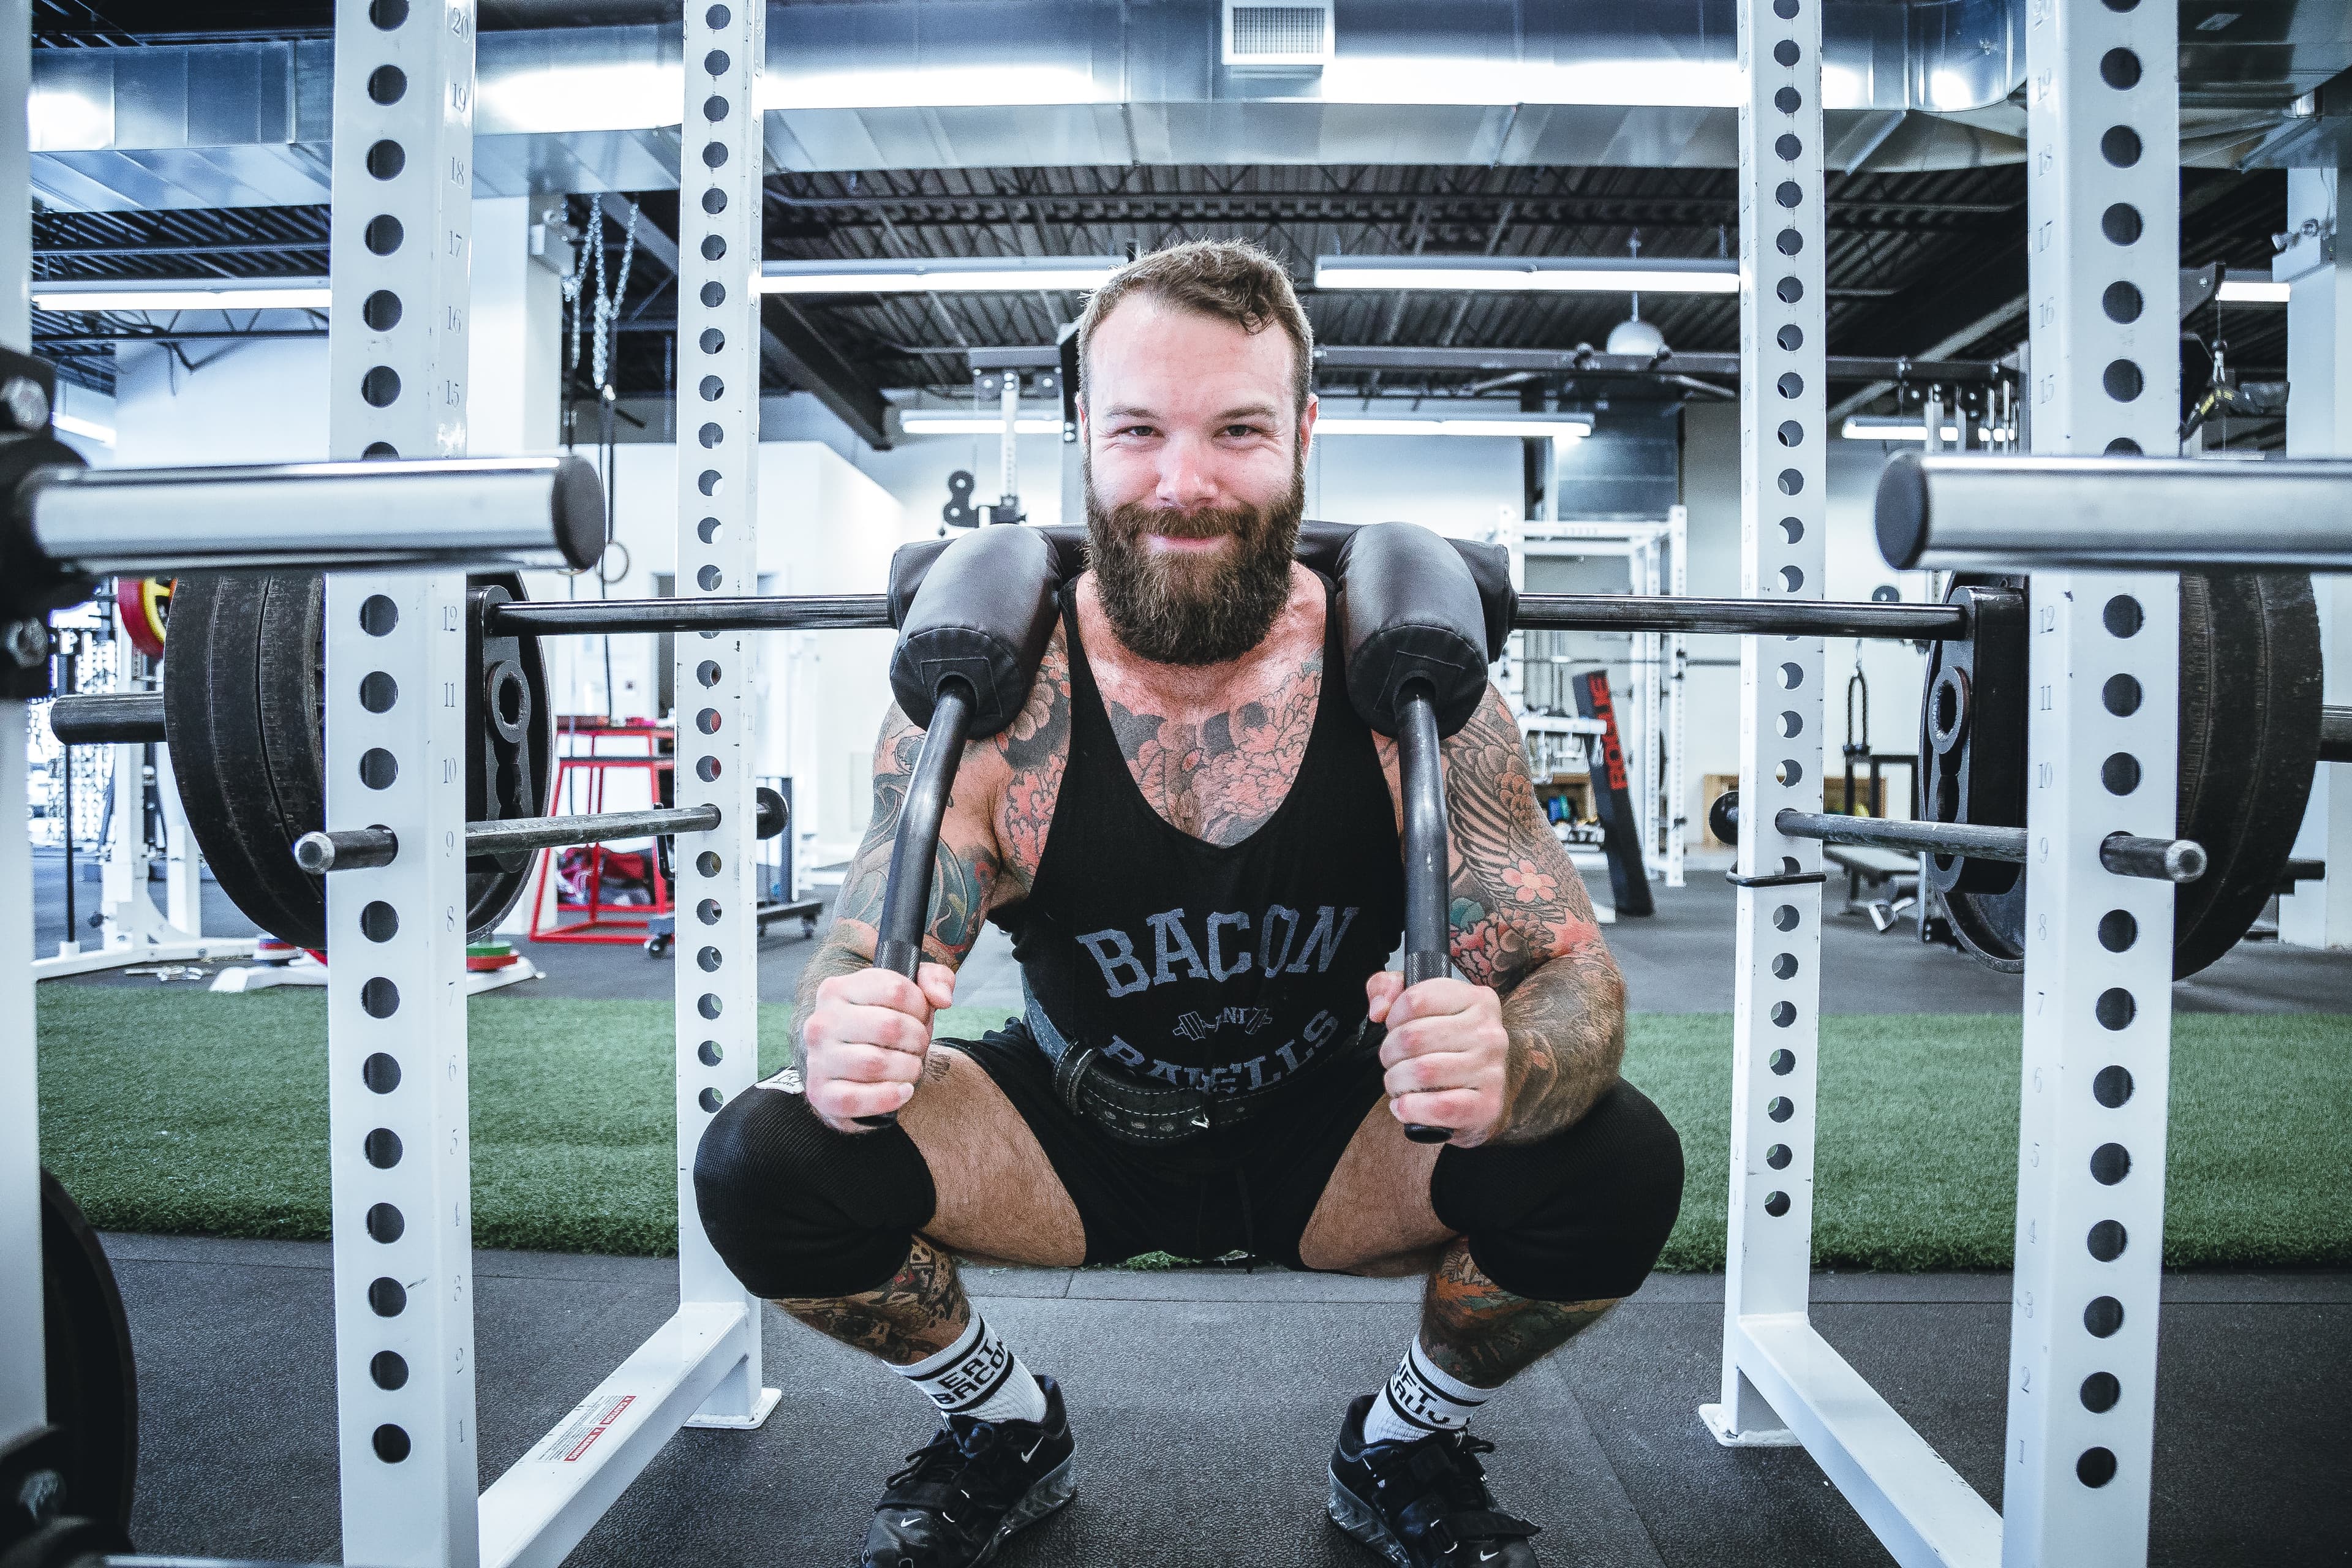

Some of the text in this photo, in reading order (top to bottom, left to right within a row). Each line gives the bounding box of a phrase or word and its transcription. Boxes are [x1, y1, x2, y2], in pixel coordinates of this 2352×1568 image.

[451, 7, 470, 42] 20
[452, 83, 466, 113] 19
[2037, 67, 2052, 102] 19
[450, 156, 464, 188] 18
[2037, 144, 2052, 178] 18
[448, 230, 463, 258] 17
[2037, 220, 2053, 253] 17
[447, 305, 461, 335] 16
[2038, 296, 2055, 330] 16
[445, 379, 460, 409] 15
[2039, 374, 2055, 405] 15
[443, 605, 458, 632] 12
[2039, 605, 2056, 634] 12
[443, 681, 456, 708] 11
[2039, 684, 2053, 711] 11
[443, 757, 457, 784] 10
[2038, 761, 2053, 788] 10
[445, 831, 454, 858] 9
[2038, 837, 2049, 864] 9
[447, 905, 455, 932] 8
[2038, 913, 2047, 941] 8
[1075, 904, 1360, 998] BACON
[448, 981, 456, 1007] 7
[2036, 990, 2045, 1017] 7
[448, 1054, 457, 1082] 6
[2033, 1066, 2043, 1093] 6
[449, 1128, 458, 1156] 5
[2030, 1141, 2040, 1168] 5
[453, 1274, 462, 1302] 3
[456, 1347, 465, 1375] 2
[937, 1338, 993, 1390] EAT
[2020, 1365, 2031, 1395] 2
[603, 1401, 627, 1423] CAUTION
[458, 1419, 466, 1444] 1
[568, 1433, 598, 1460] WARNING
